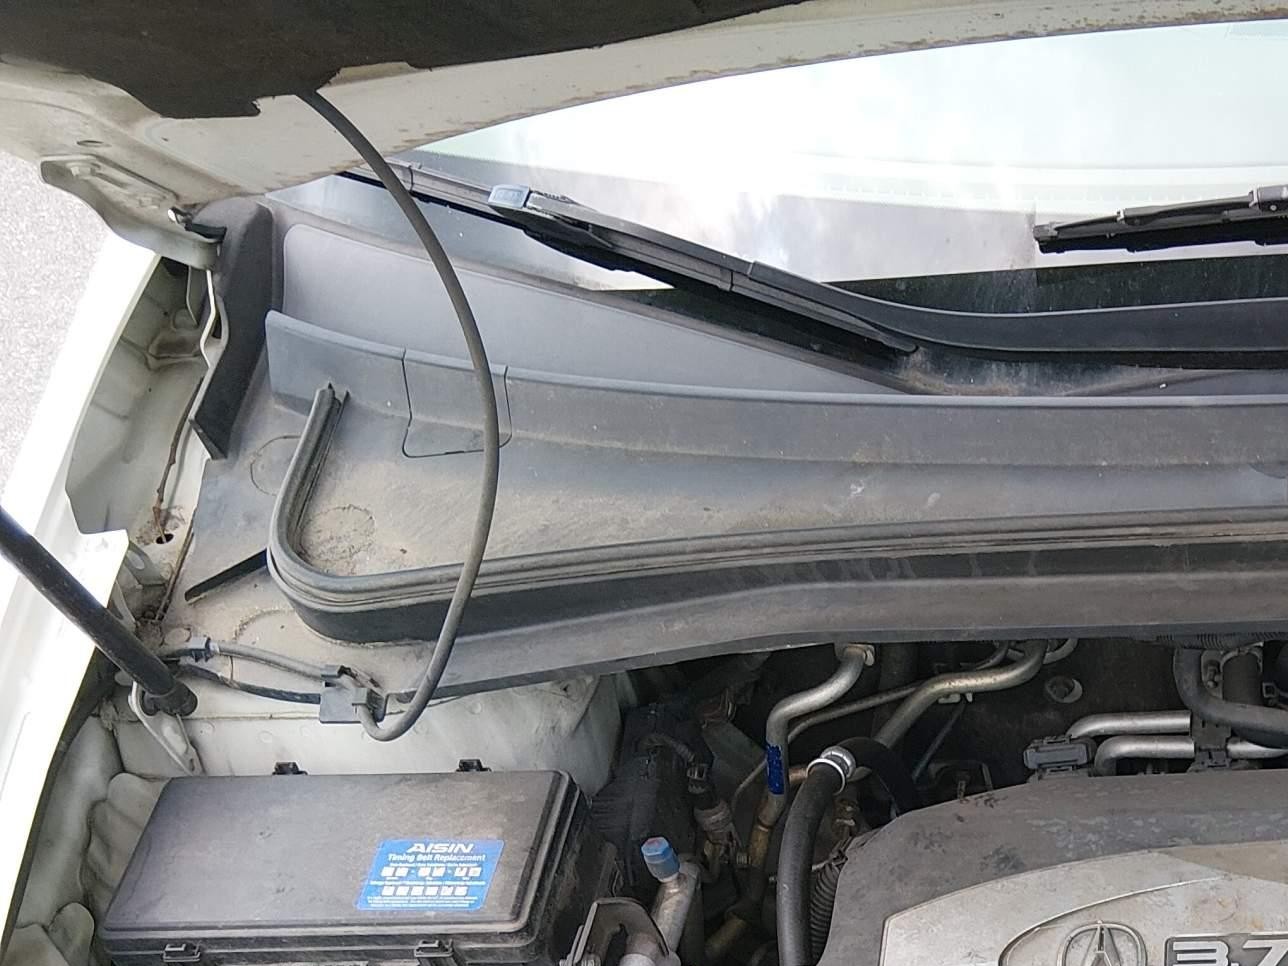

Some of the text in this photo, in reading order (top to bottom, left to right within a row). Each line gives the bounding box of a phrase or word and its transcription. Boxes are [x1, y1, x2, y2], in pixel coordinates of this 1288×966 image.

[406, 843, 474, 853] AISIN
[388, 853, 486, 862] Timing Belt Replacement
